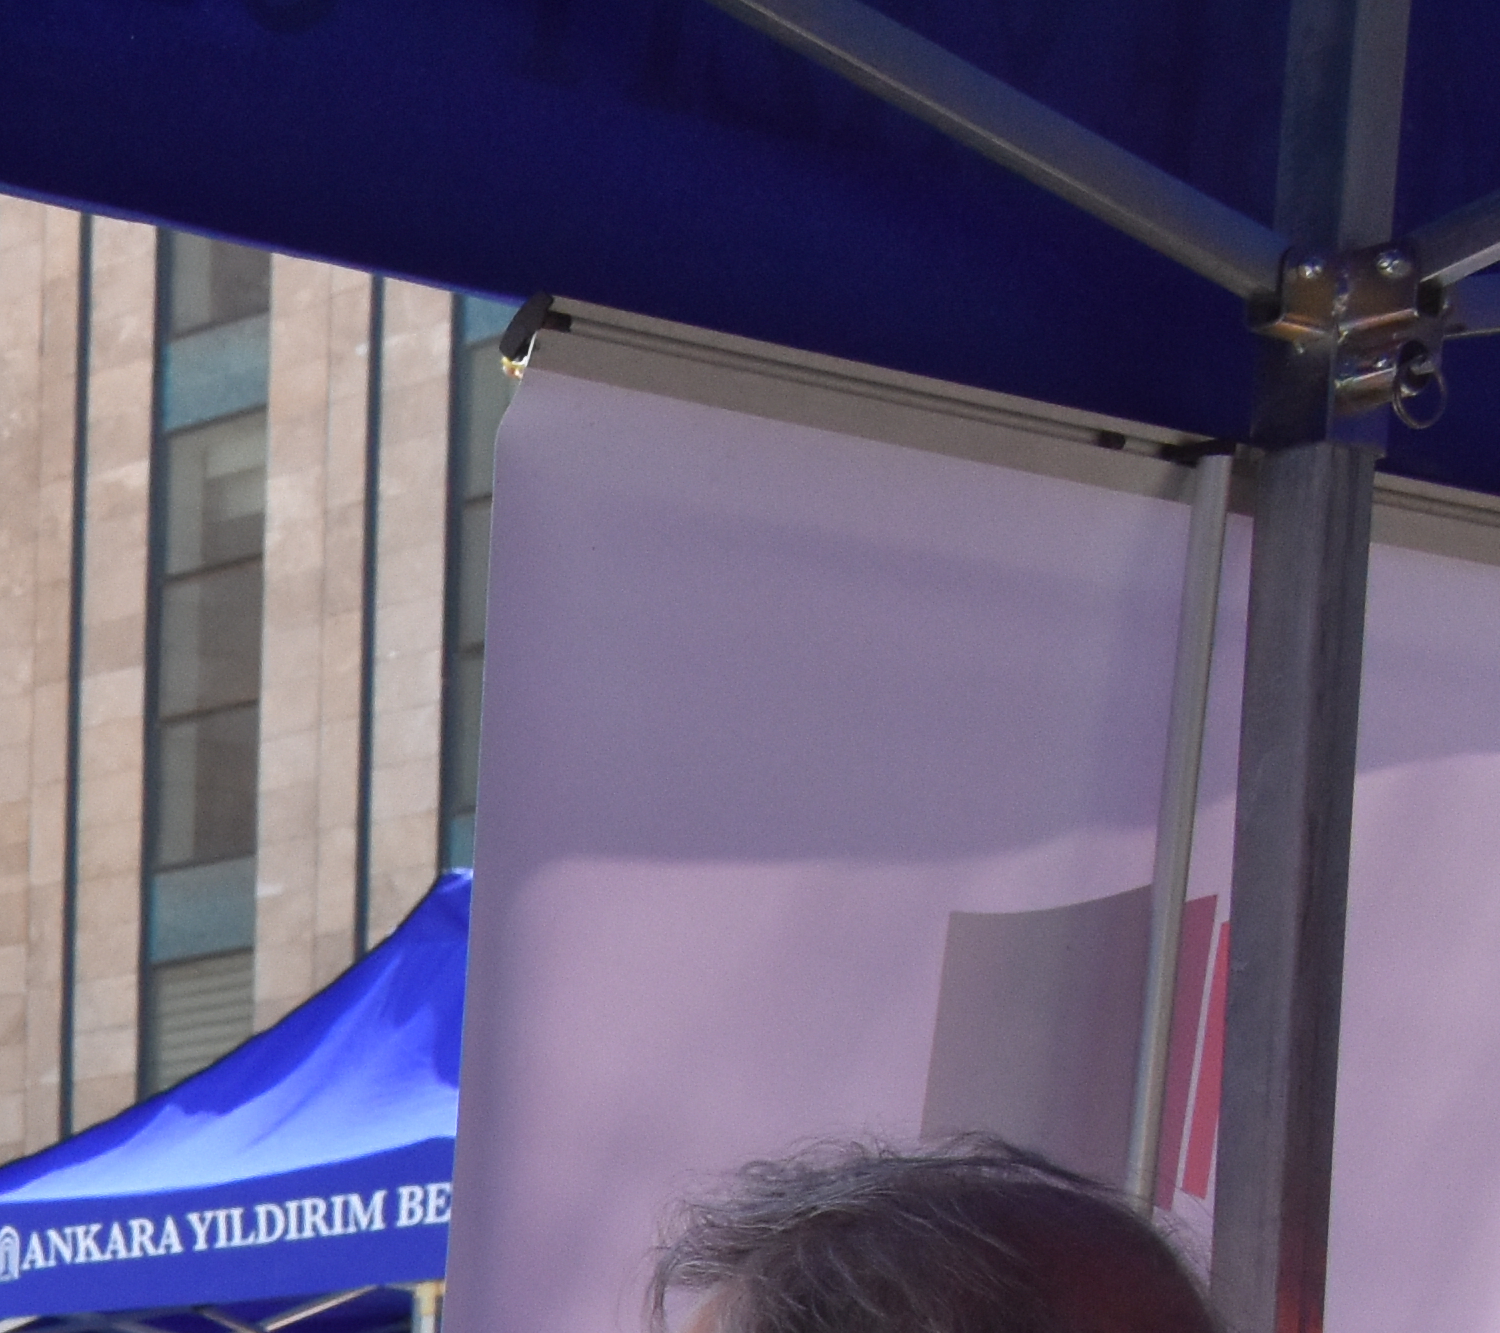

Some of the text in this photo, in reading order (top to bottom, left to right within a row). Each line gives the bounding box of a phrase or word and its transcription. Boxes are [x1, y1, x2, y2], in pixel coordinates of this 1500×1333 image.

[21, 1182, 453, 1272] ANKARA YILDIRIM BE
